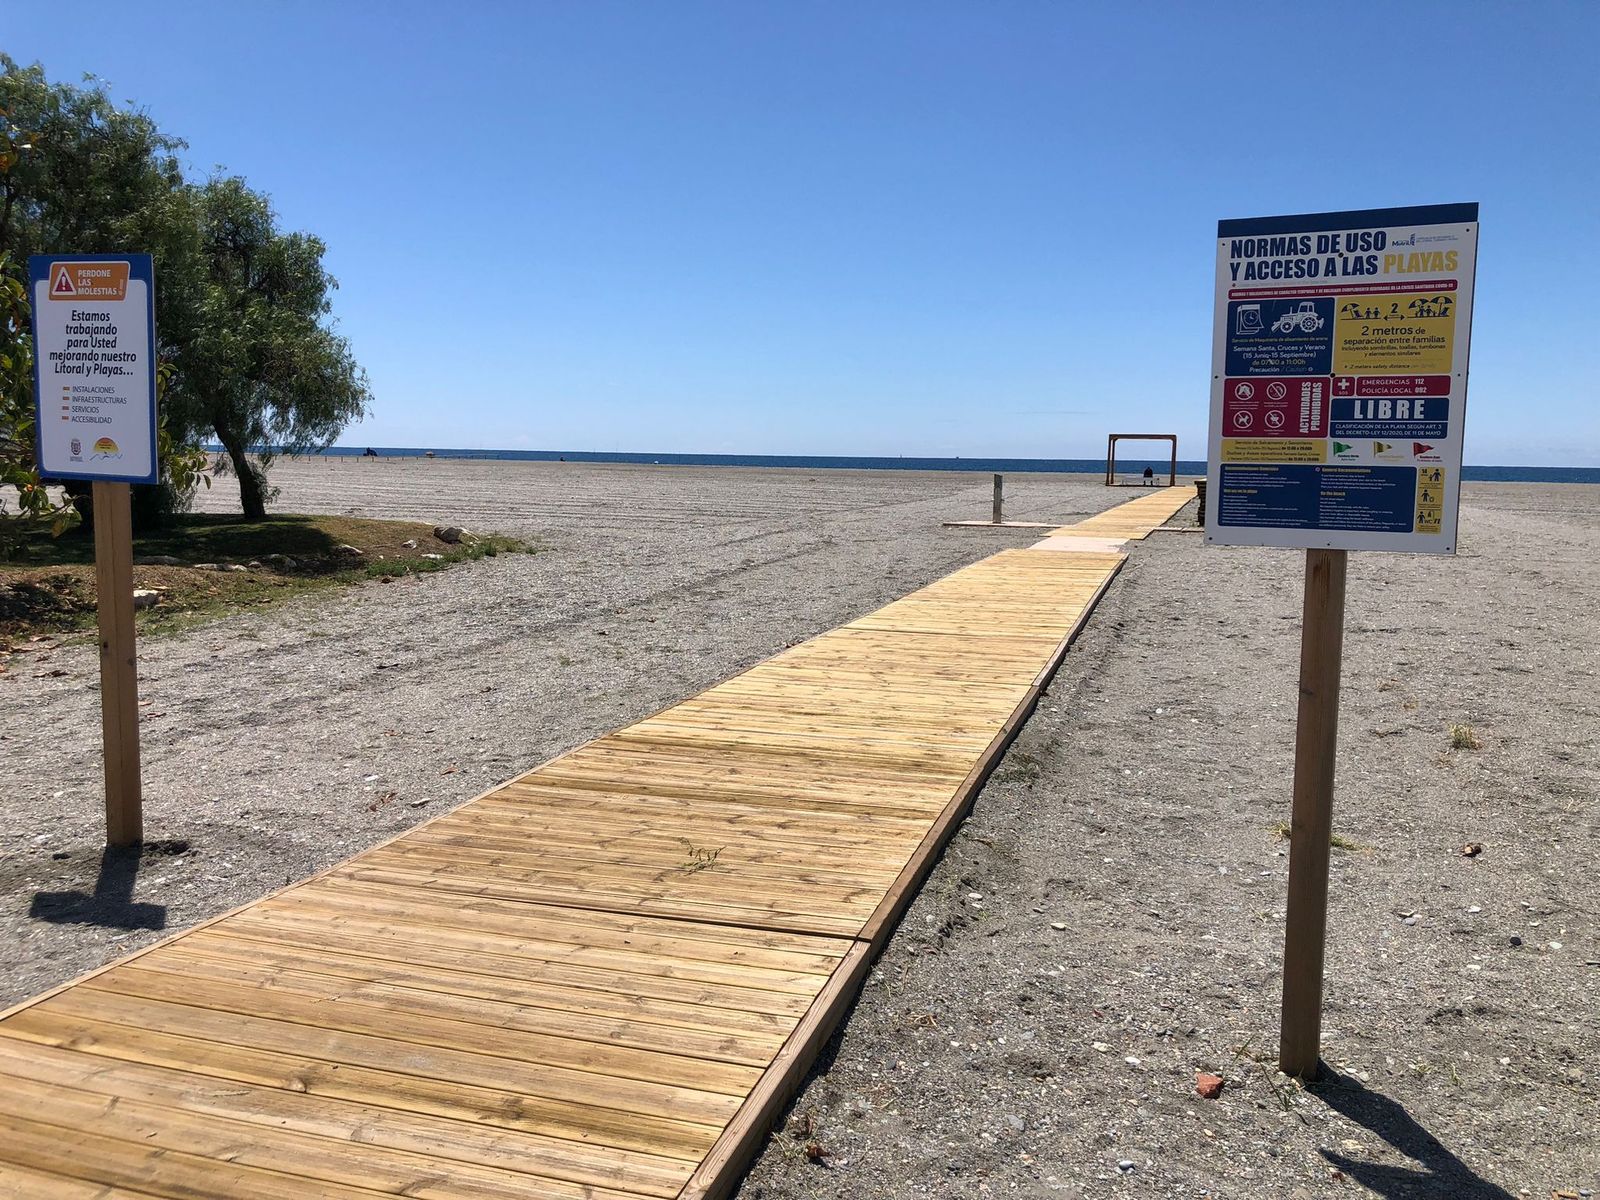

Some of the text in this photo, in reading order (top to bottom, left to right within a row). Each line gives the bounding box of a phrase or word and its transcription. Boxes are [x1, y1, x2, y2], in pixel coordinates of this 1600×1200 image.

[1230, 230, 1387, 258] NORMAS DE USO
[1230, 250, 1458, 281] Y ACCESO A LAS PLAYAS
[78, 269, 111, 278] PERDONE
[78, 278, 92, 286] LAS
[78, 287, 117, 296] MOLESTIAS
[1391, 303, 1398, 313] 2
[72, 310, 110, 322] Estamos
[66, 323, 117, 337] trabajando
[1361, 326, 1369, 336] 2
[1372, 327, 1413, 335] metros
[67, 337, 116, 350] para Usted
[1344, 337, 1387, 346] separación
[50, 350, 137, 364] mejorando nuestro
[55, 362, 133, 378] Litoral y Playas...
[72, 396, 127, 404] INFRAESTRUCTURAS
[1300, 382, 1311, 433] ACTIVIDADES
[1311, 382, 1322, 431] PROHIBIDAS
[1354, 400, 1425, 419] LIBRE
[72, 416, 112, 424] ACCESIBILIDAD
